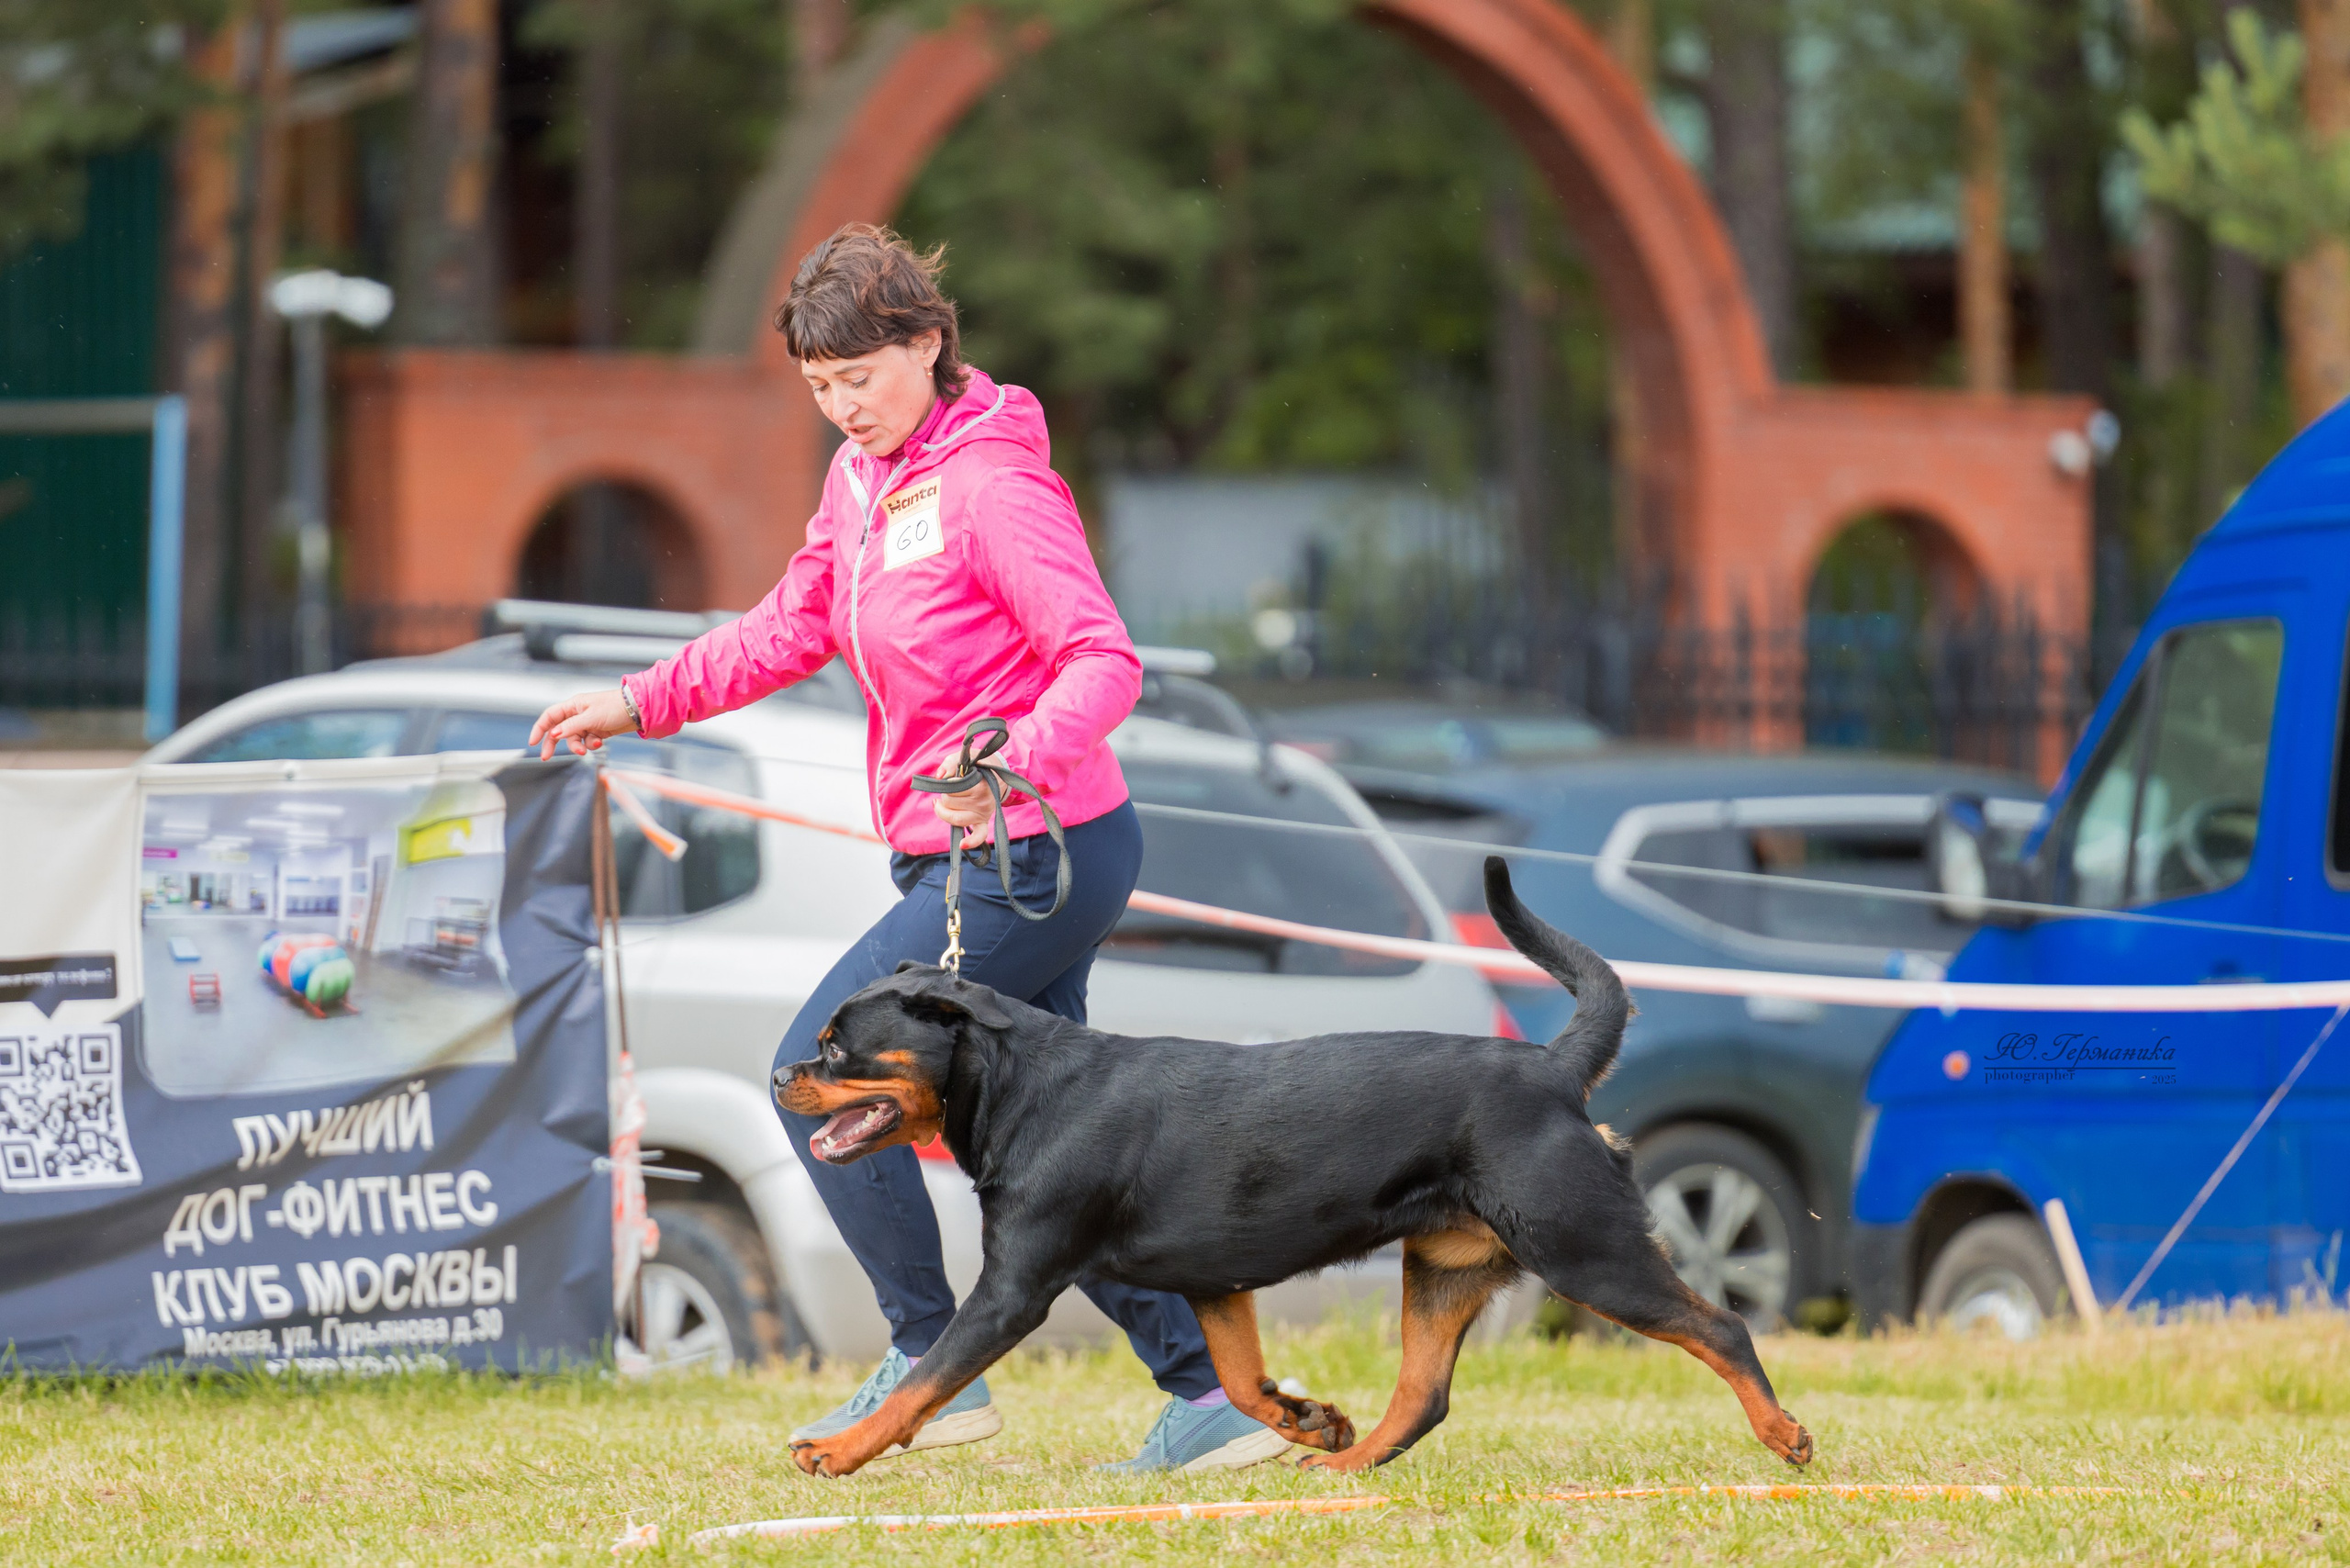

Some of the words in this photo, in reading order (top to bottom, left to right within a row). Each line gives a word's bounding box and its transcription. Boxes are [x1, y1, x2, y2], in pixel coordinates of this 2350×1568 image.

[897, 520, 929, 551] 60
[232, 1079, 434, 1171] ЛУЧШИЙ
[163, 1169, 498, 1258] ДОГ-ФИТНЕС
[151, 1263, 294, 1327] КЛУБ
[296, 1245, 517, 1316] МОСКВЫ
[183, 1327, 277, 1358] Москва,
[282, 1326, 318, 1358] ул.
[321, 1316, 450, 1356] Гурьянова
